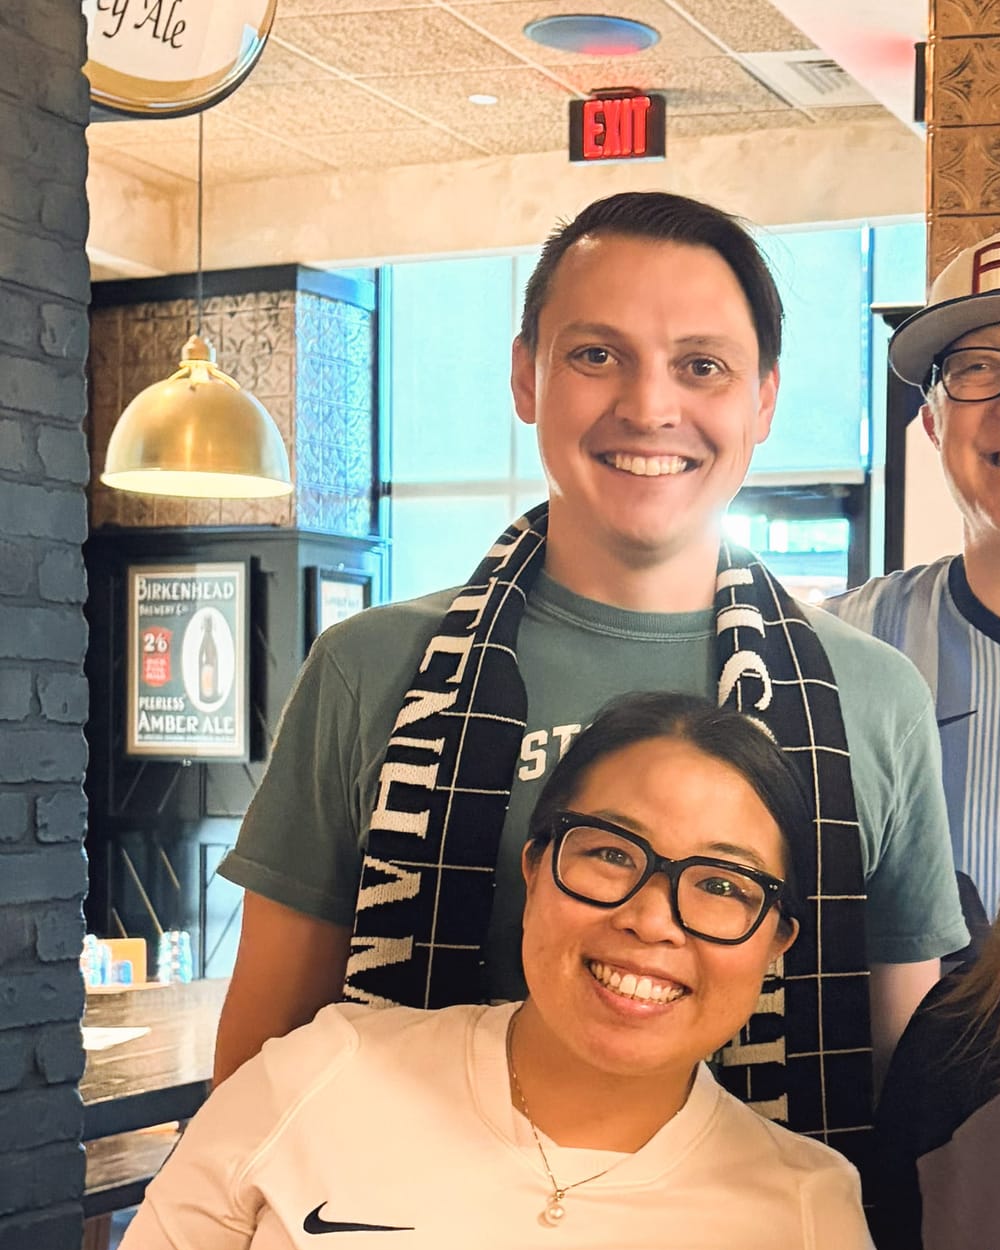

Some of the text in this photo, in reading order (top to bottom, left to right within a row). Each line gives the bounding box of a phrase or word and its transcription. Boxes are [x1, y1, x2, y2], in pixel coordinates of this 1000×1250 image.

[134, 0, 186, 48] Ale
[583, 96, 650, 158] EXIT
[138, 577, 235, 601] BIRKENHEAD
[139, 696, 185, 711] PEERLESS
[138, 709, 235, 734] AMBER ALE
